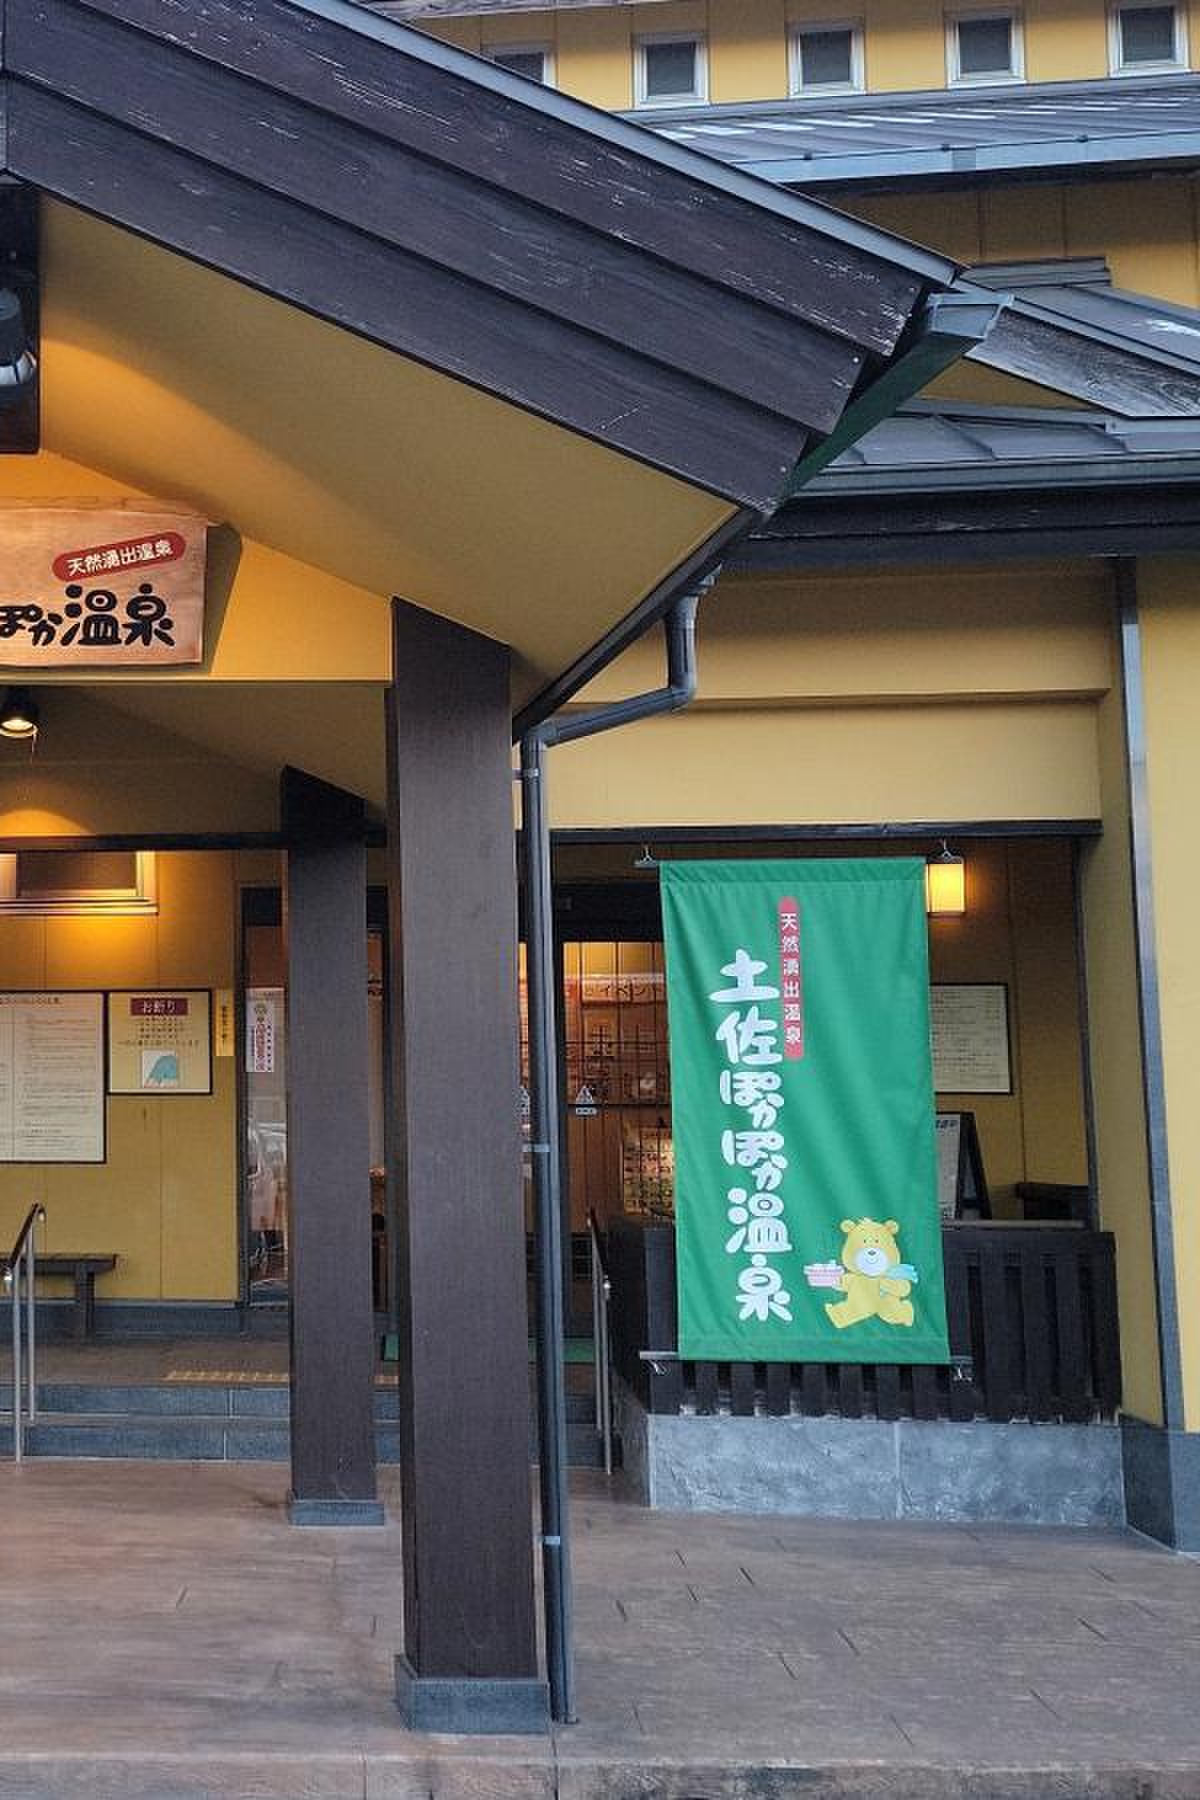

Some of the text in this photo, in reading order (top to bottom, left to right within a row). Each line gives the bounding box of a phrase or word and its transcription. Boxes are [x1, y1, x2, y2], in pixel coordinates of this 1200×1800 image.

[66, 538, 174, 577] 天然湧出温泉
[780, 912, 802, 1044] 天然湧出温泉
[708, 948, 794, 1322] 土佐ぽかぽか温泉
